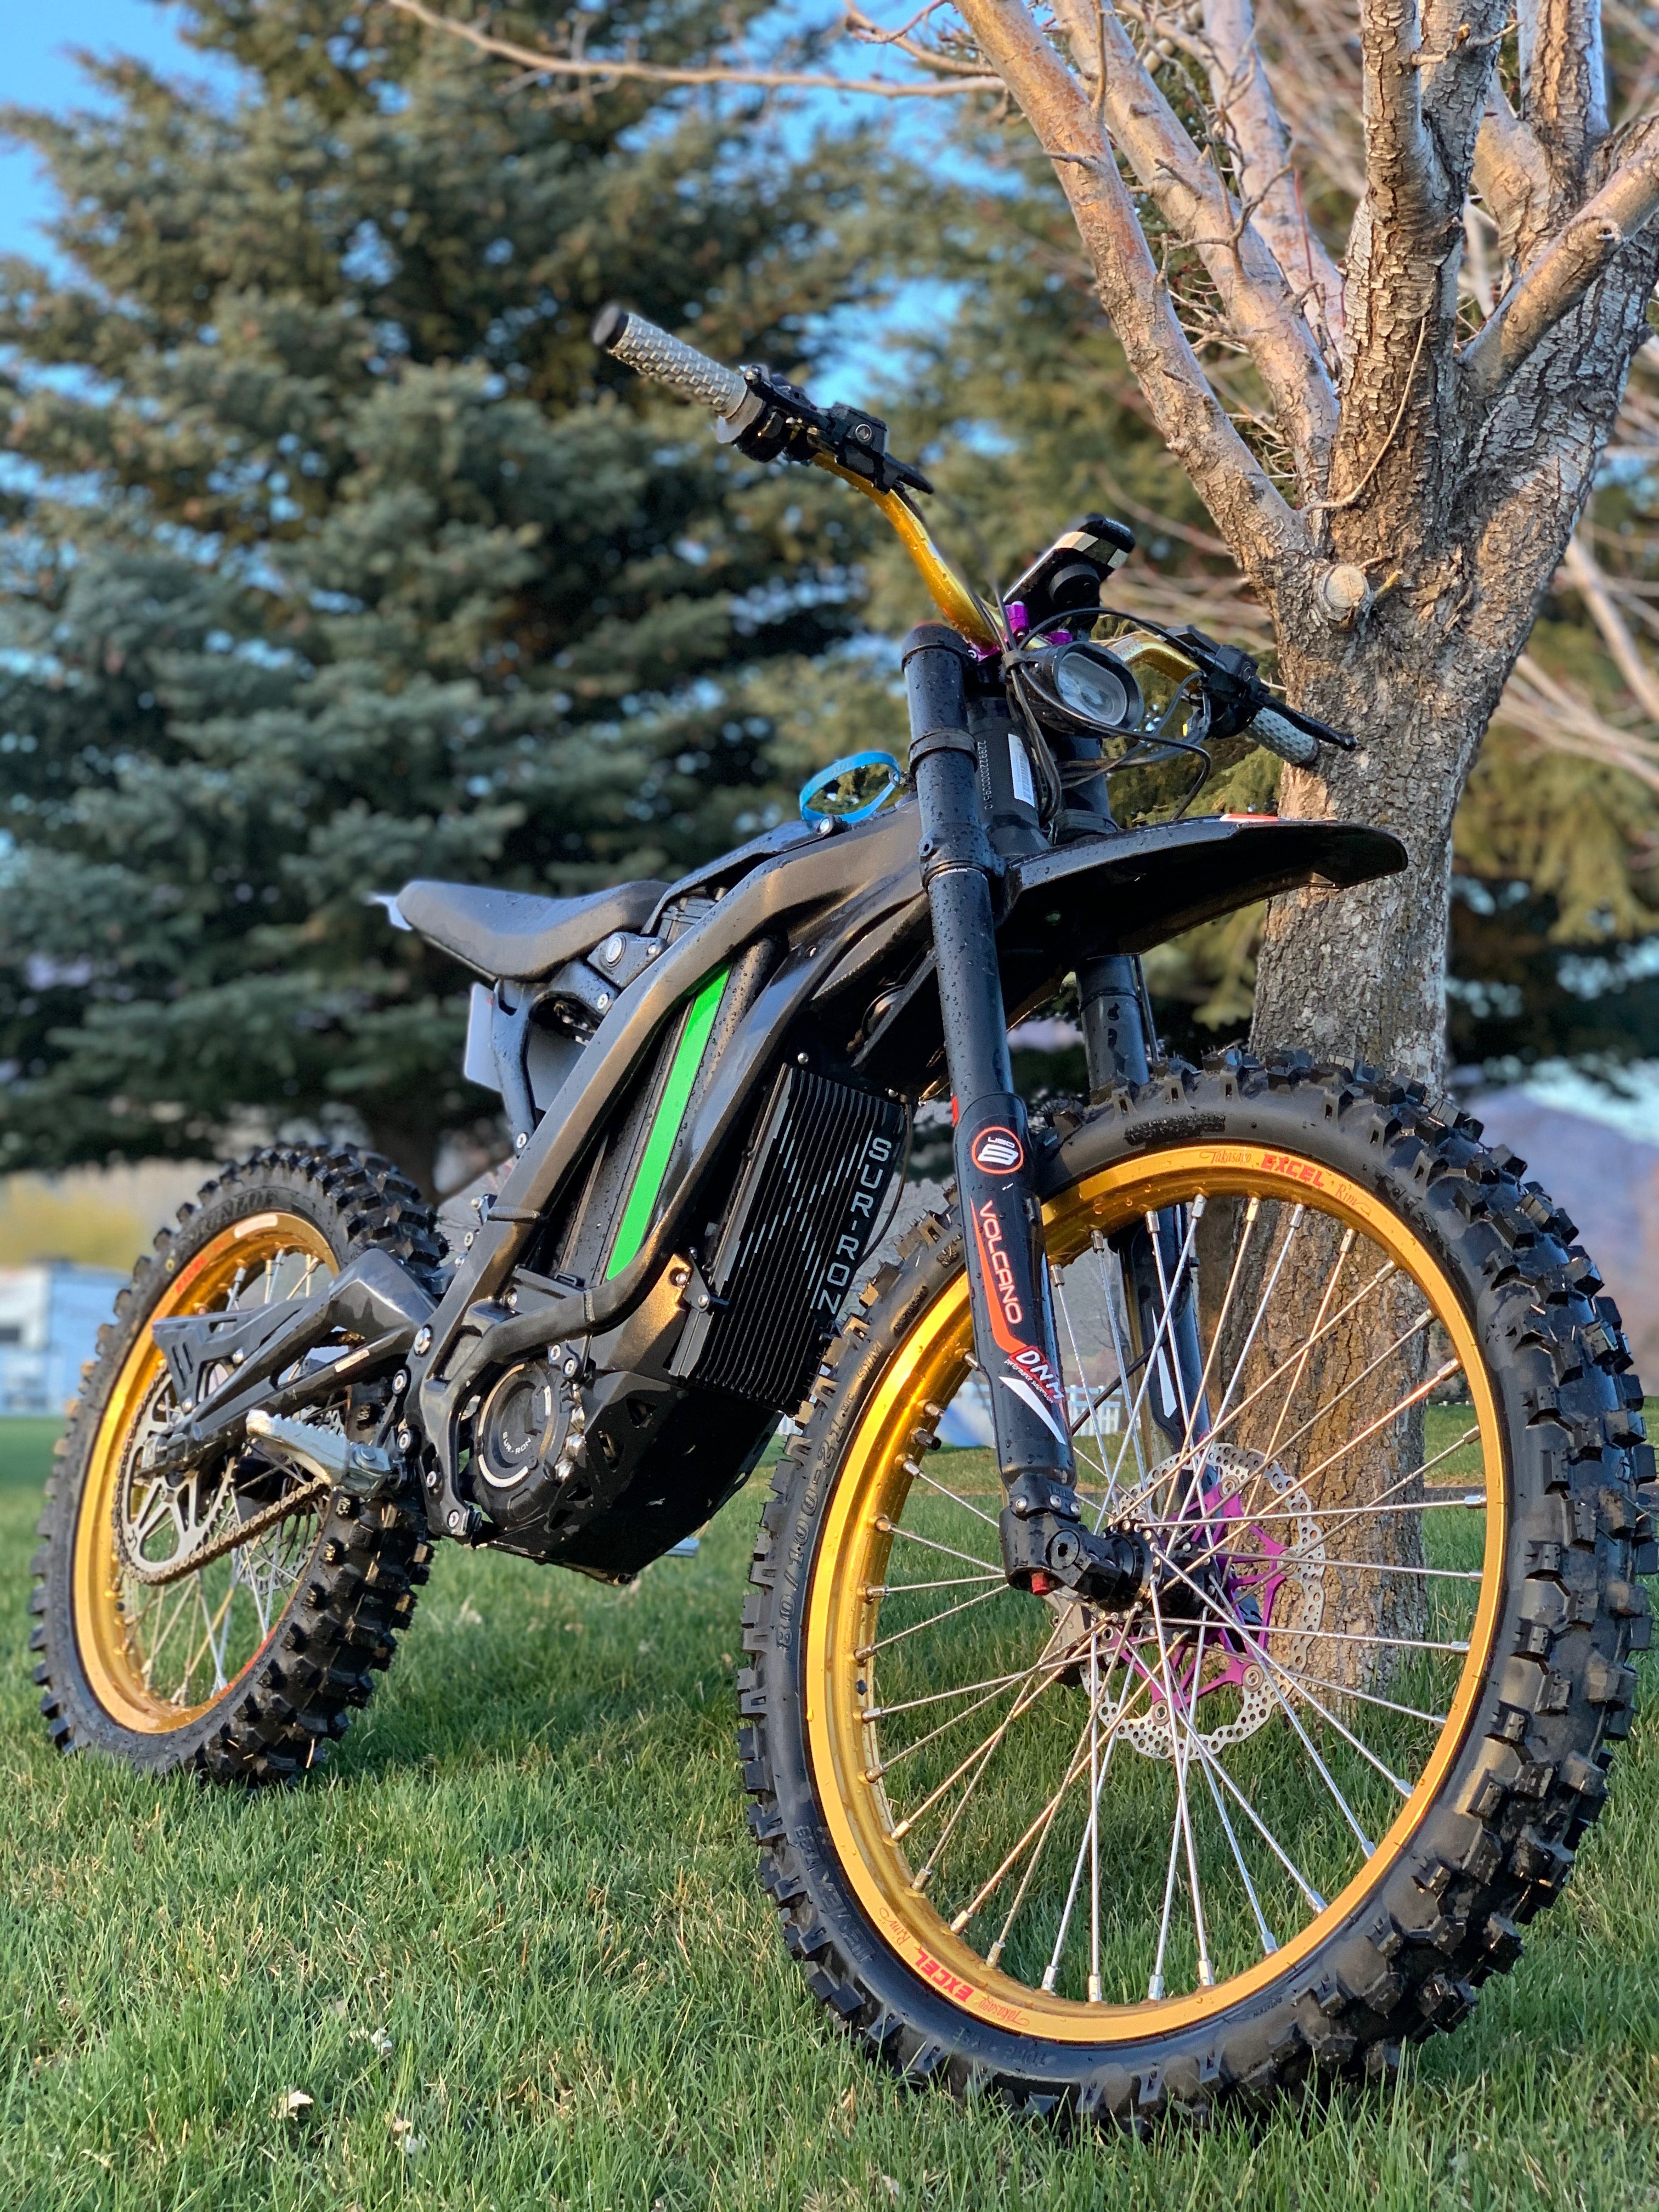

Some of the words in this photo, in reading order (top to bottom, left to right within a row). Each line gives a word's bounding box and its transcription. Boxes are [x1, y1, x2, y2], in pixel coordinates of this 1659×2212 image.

[988, 1136, 1015, 1149] USD
[1199, 1149, 1252, 1165] Takasago
[1260, 1152, 1324, 1188] EXCEL
[1334, 1183, 1372, 1217] Rim
[979, 1199, 1023, 1325] VOLCANO
[1003, 1358, 1032, 1384] performance
[1030, 1379, 1054, 1404] suspension
[1015, 1350, 1065, 1400] DNM
[776, 1419, 847, 1652] 80/100-21
[879, 1907, 911, 1946] Rim
[915, 1948, 974, 2002] EXCEL
[978, 1996, 1030, 2027] Takasago
